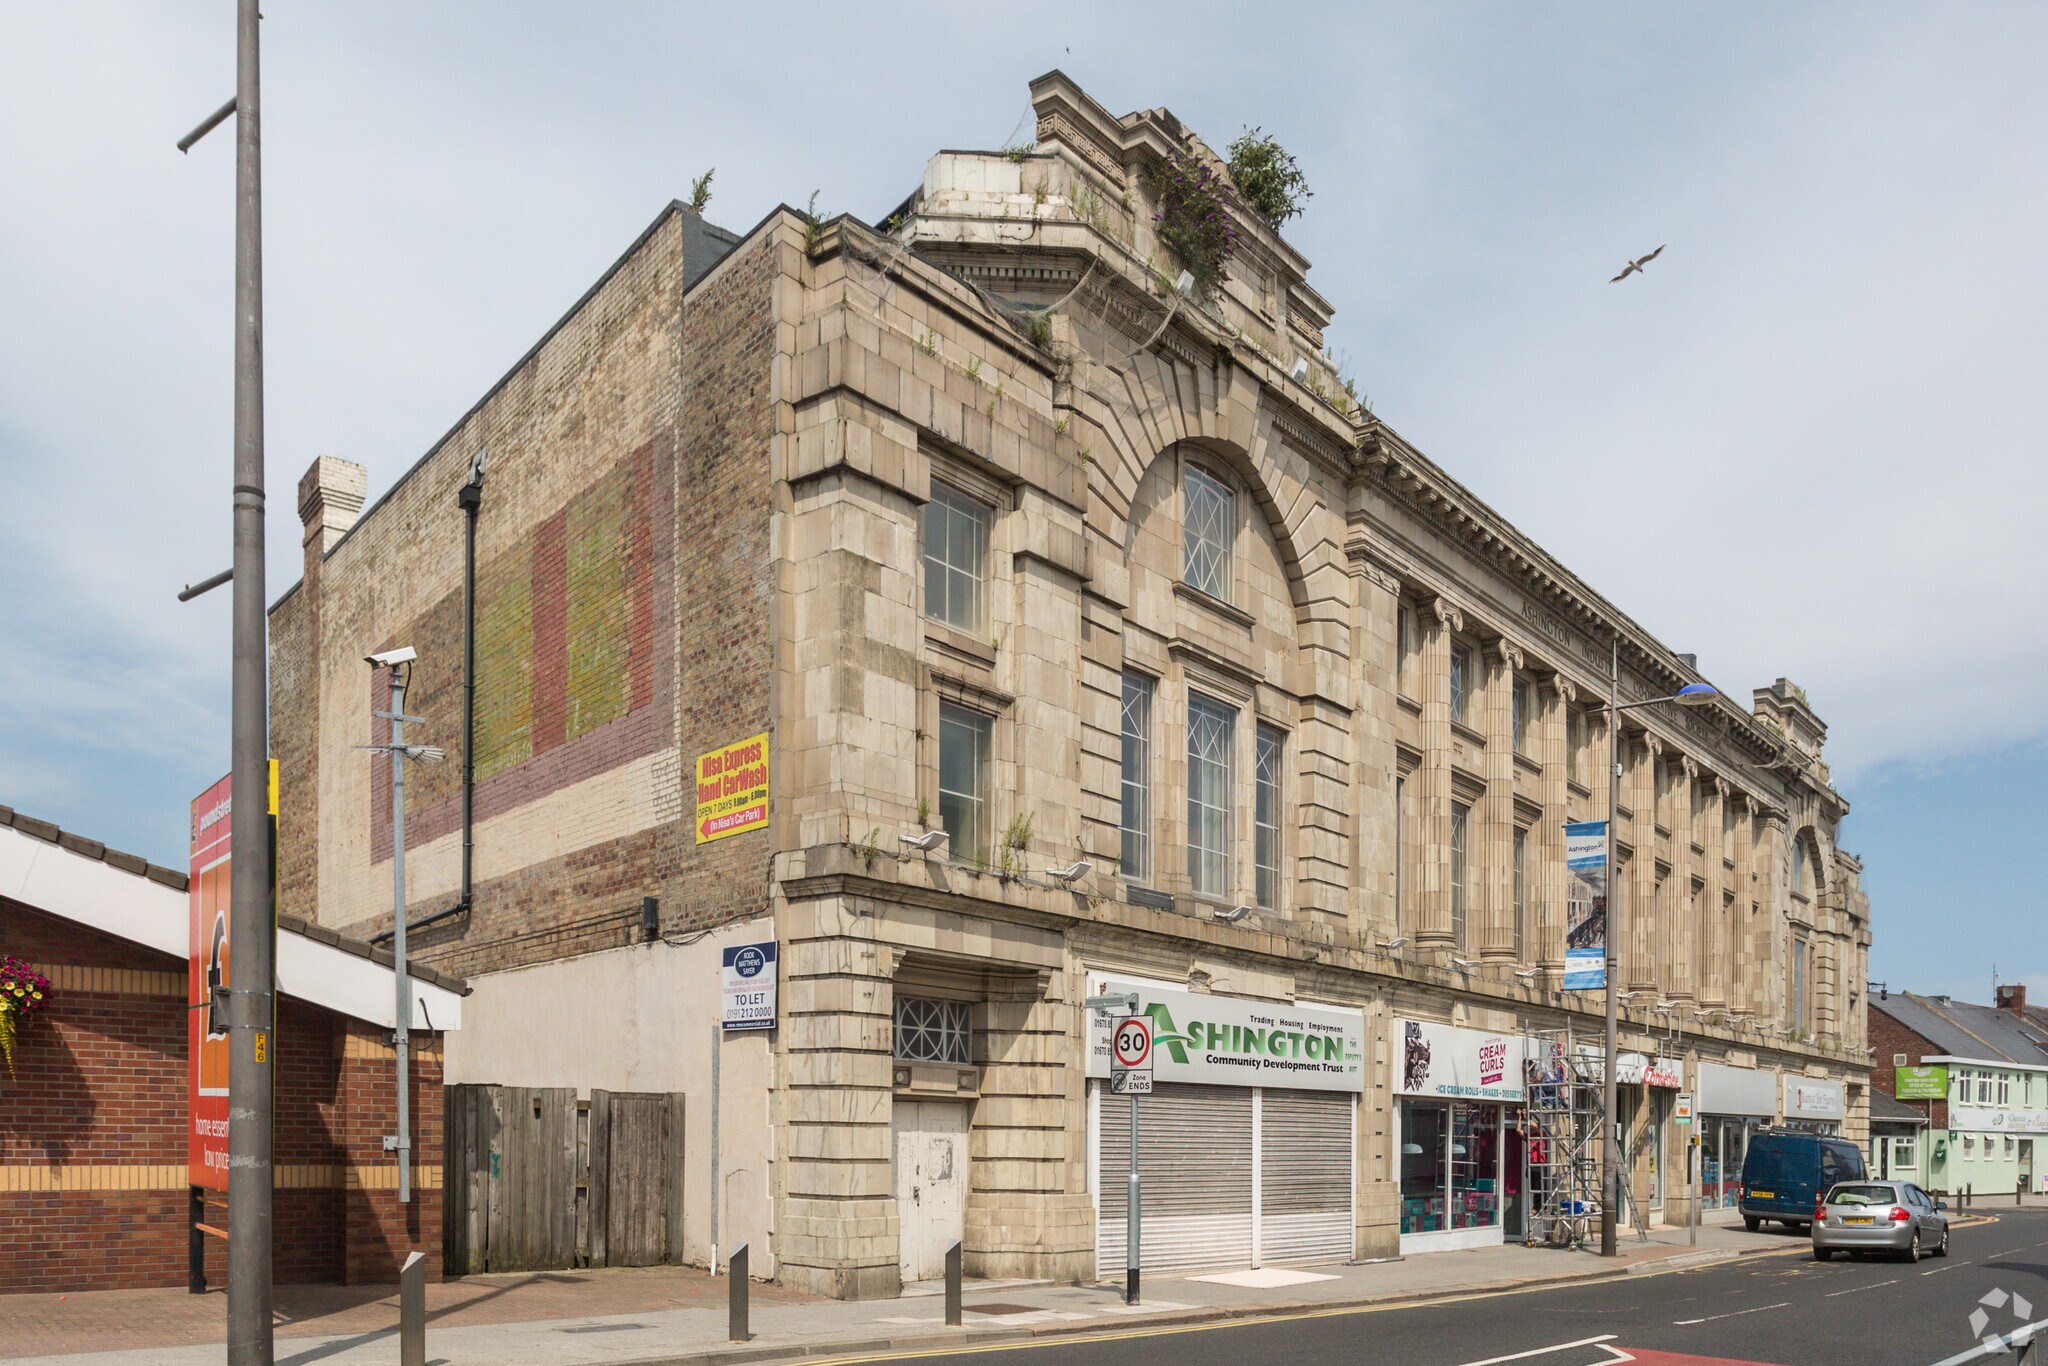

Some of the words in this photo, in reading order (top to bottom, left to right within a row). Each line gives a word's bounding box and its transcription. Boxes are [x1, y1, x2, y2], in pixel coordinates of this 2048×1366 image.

[1521, 602, 1571, 647] ASHINGTON
[1581, 643, 1624, 684] INDUSTRAL
[703, 756, 722, 779] Nisa
[724, 742, 761, 772] Express
[698, 778, 721, 804] Hand
[723, 763, 767, 796] CarWash
[698, 804, 712, 818] OPEN
[718, 800, 732, 812] DAYS
[719, 815, 734, 829] Nisa's
[735, 811, 745, 825] Car
[746, 807, 760, 821] Park)
[738, 959, 761, 967] MATTHEWS
[735, 994, 747, 1005] TO
[749, 993, 765, 1004] LET
[741, 1007, 753, 1018] 212
[754, 1006, 772, 1017] 0000
[1144, 1002, 1344, 1063] ASHINGTON
[1250, 1015, 1274, 1027] Trading
[1280, 1018, 1303, 1030] Housing
[1309, 1022, 1343, 1033] Employment
[1120, 1033, 1144, 1051] 30
[1479, 1044, 1506, 1059] CREAM
[1206, 1054, 1261, 1070] Community
[1263, 1058, 1320, 1072] Development
[1323, 1063, 1343, 1073] Trust
[1480, 1057, 1504, 1073] CURLS
[1129, 1082, 1150, 1090] ENDS
[1438, 1085, 1446, 1094] ICE
[1447, 1085, 1464, 1095] CREAM
[1465, 1086, 1478, 1096] ROLLS
[1482, 1088, 1499, 1097] SHAKES
[1502, 1089, 1522, 1099] DESSERTS
[196, 1111, 211, 1136] home
[204, 1142, 214, 1167] low
